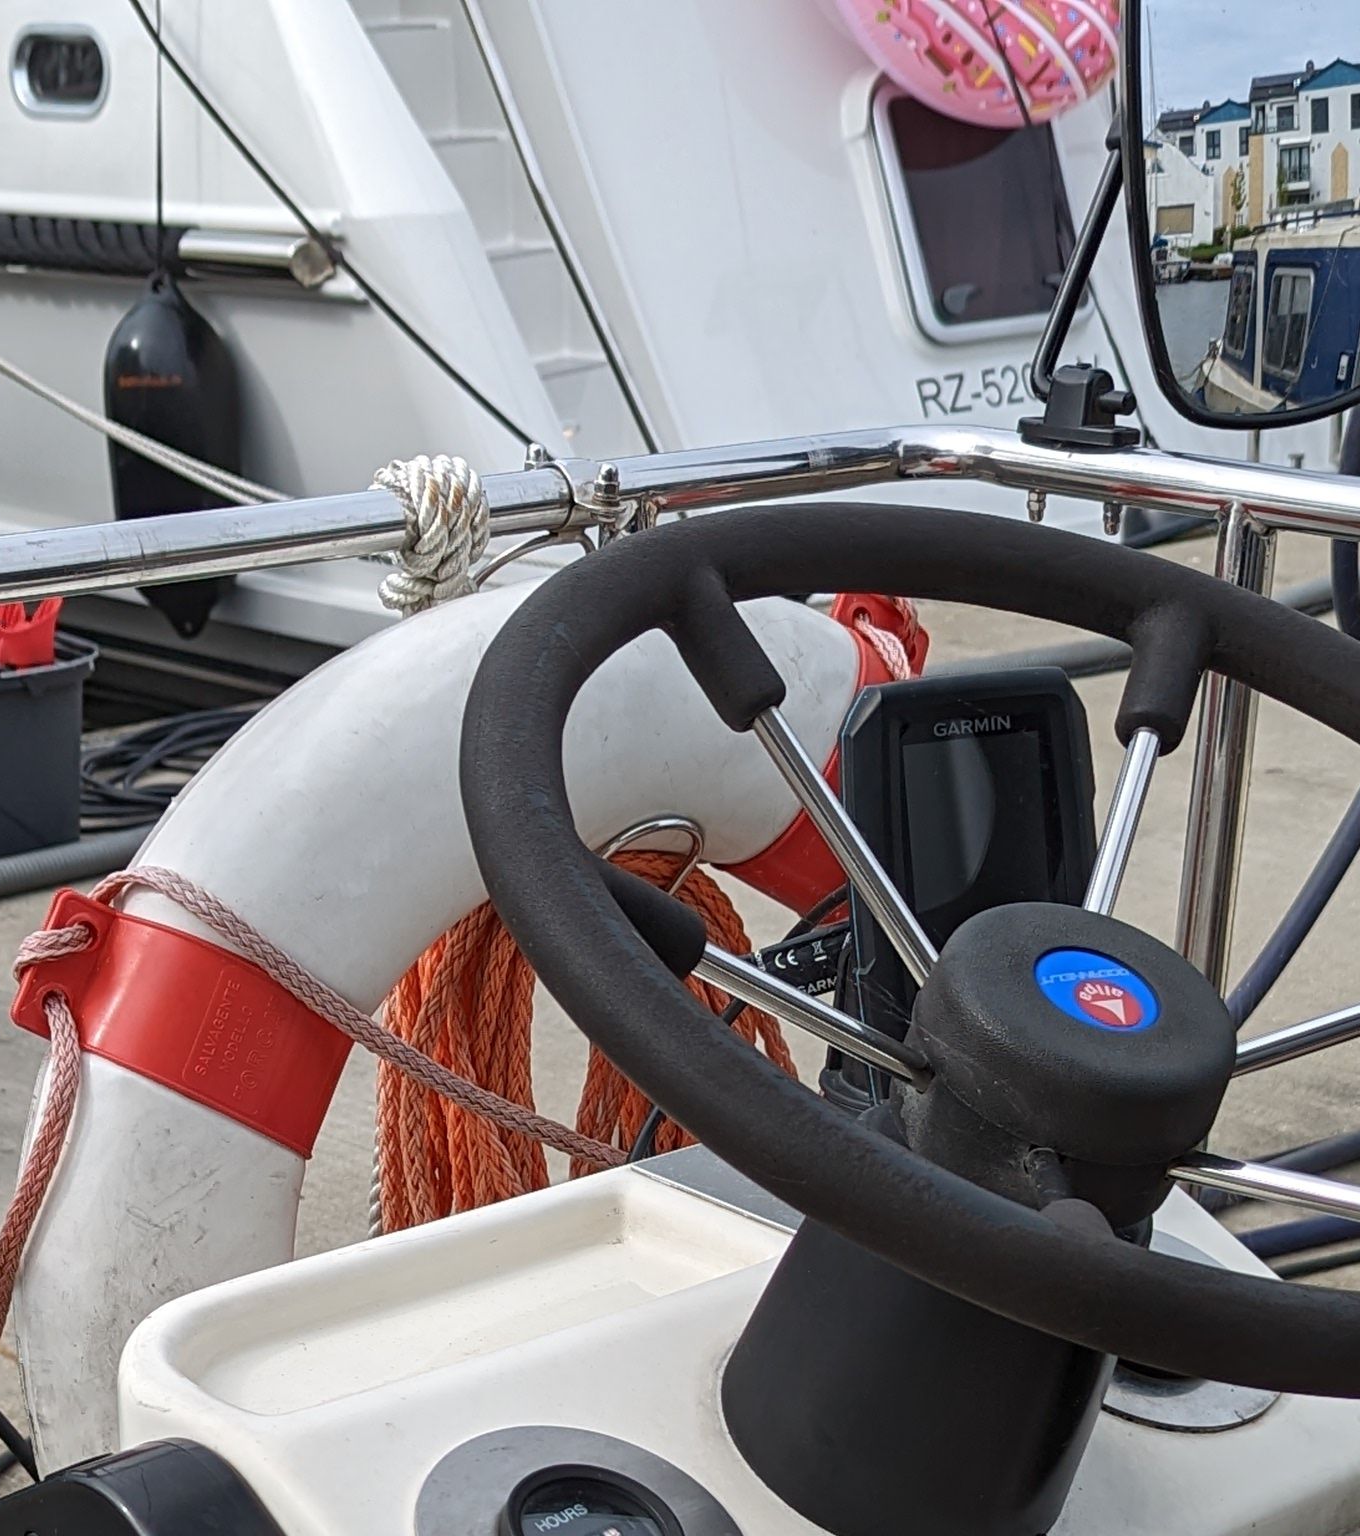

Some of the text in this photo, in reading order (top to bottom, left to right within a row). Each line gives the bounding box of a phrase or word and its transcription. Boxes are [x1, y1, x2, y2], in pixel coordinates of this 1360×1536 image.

[933, 715, 1011, 737] GARMIN
[194, 979, 240, 1076] SALVAGENTE
[534, 1503, 589, 1532] HOURS
